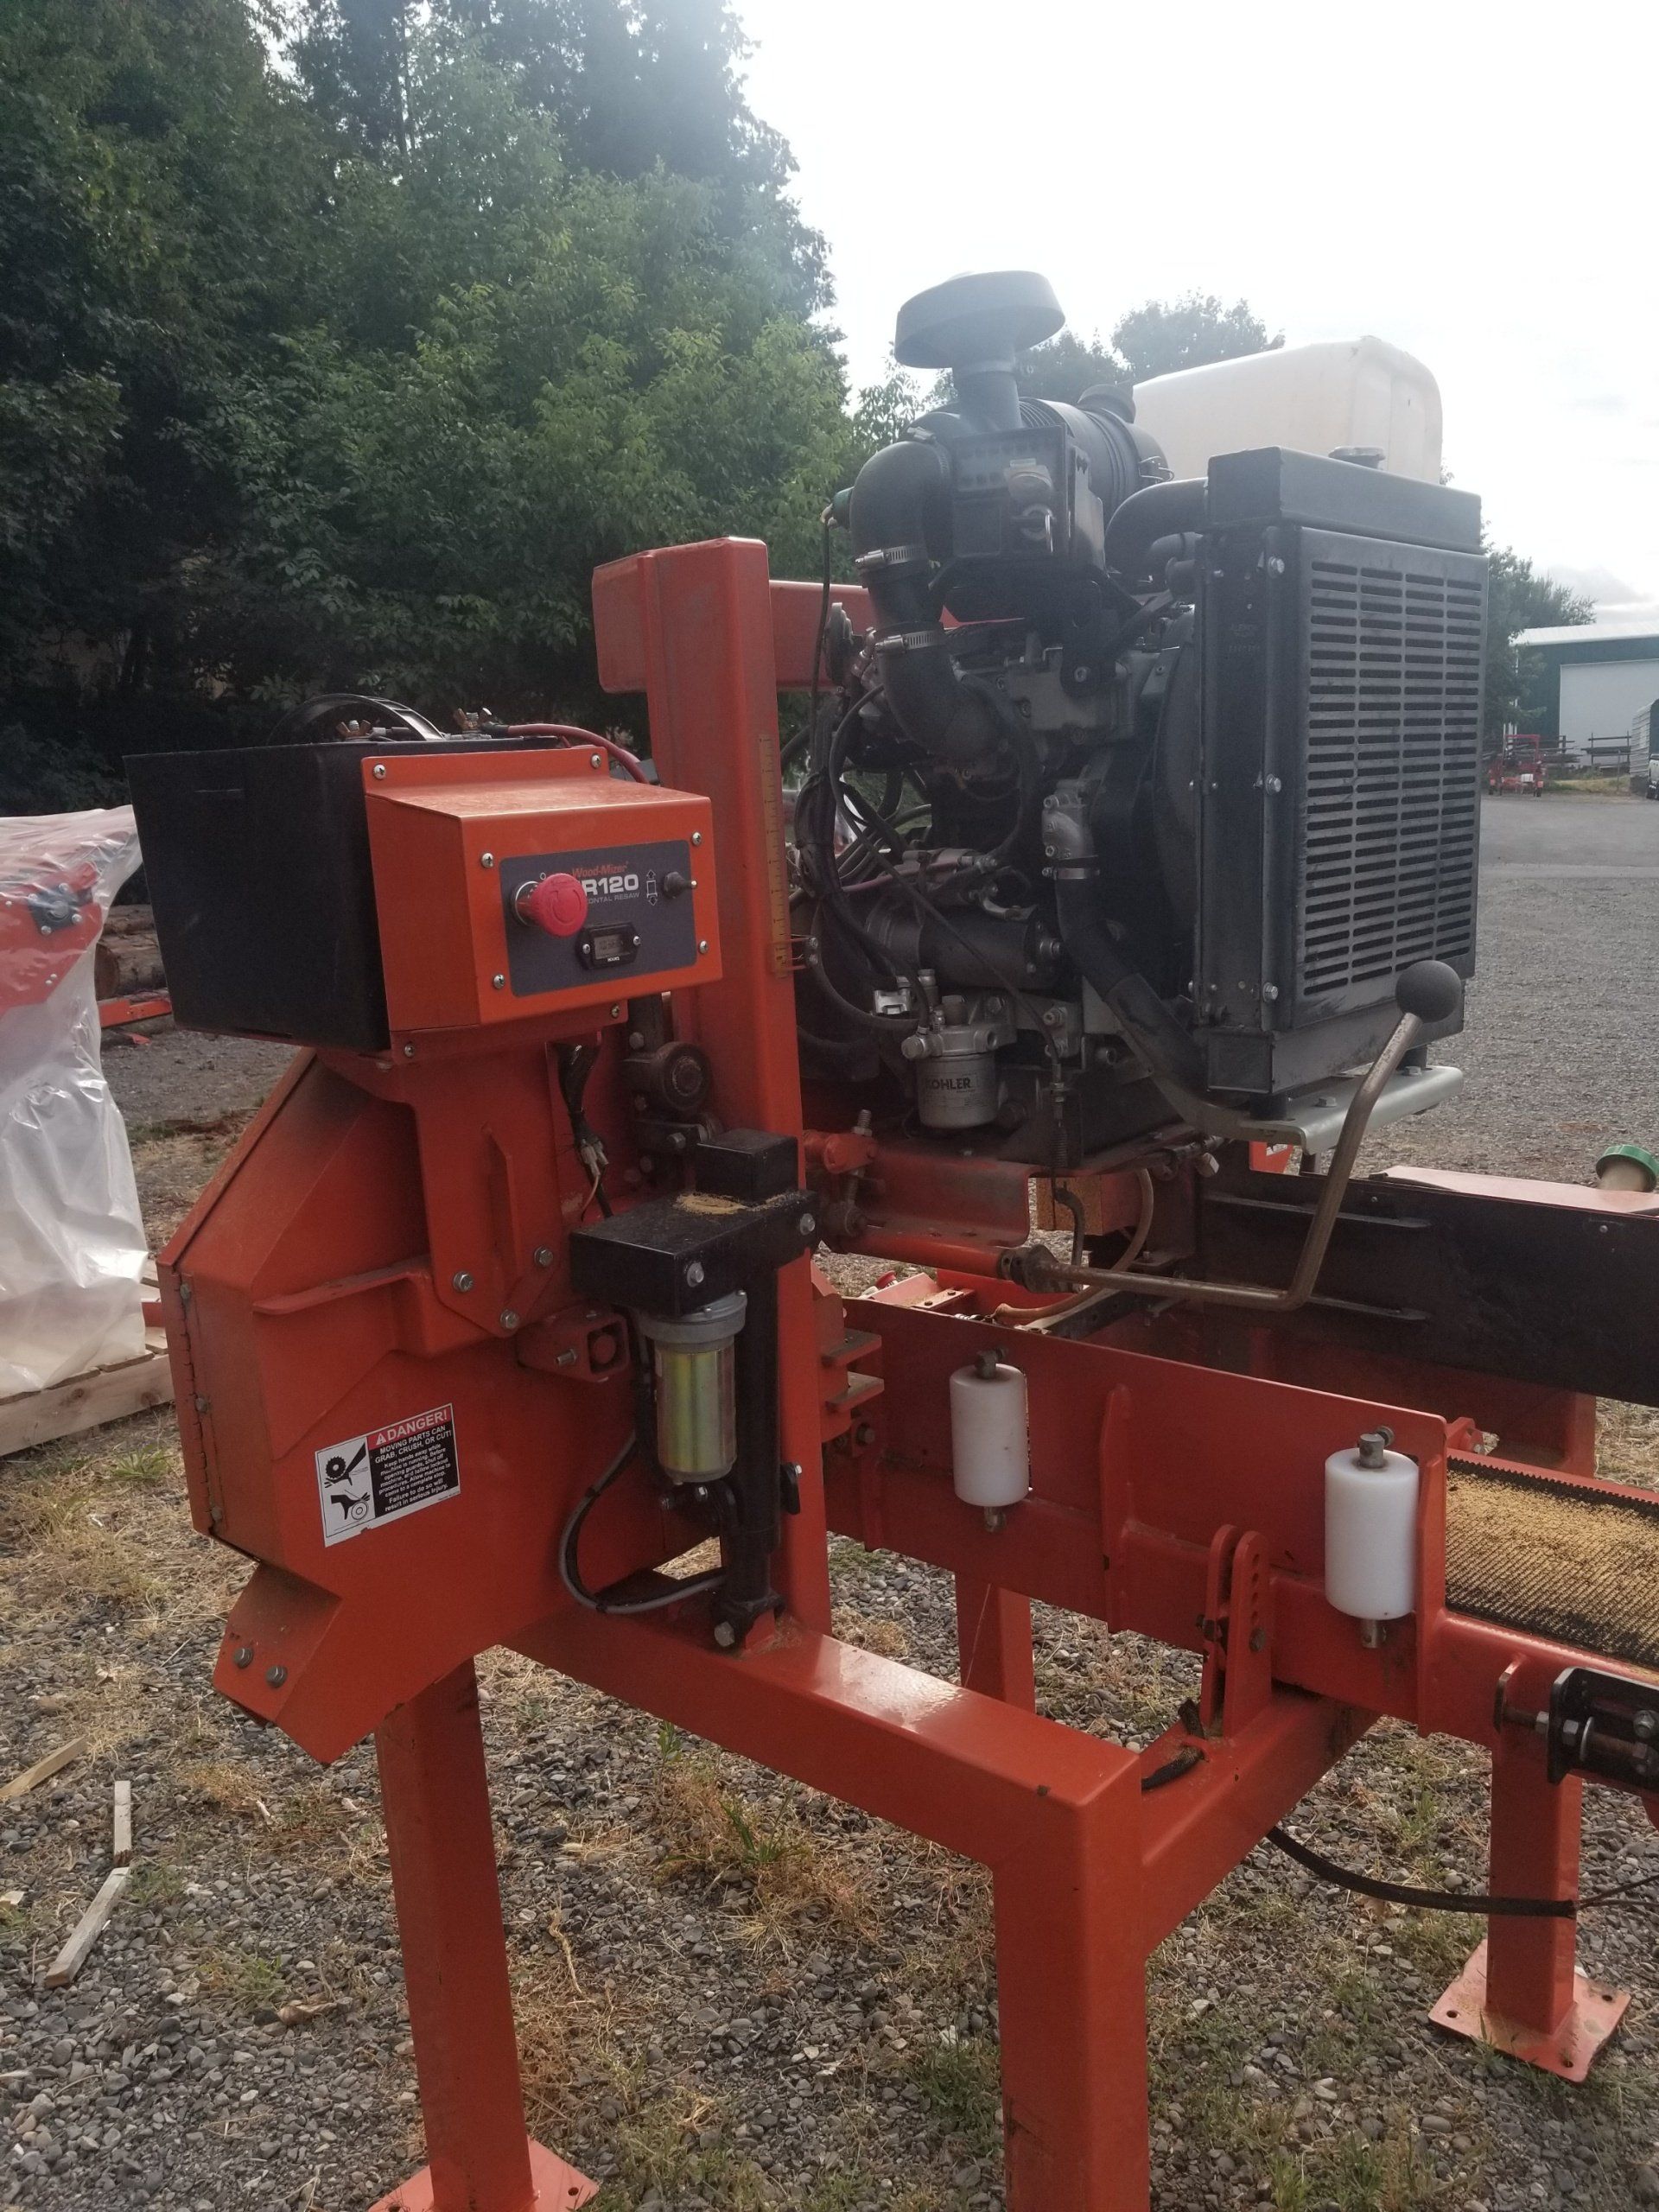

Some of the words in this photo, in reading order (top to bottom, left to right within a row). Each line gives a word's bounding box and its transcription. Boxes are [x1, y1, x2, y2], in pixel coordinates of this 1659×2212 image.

[572, 864, 626, 877] Wood-Mizer
[581, 874, 639, 896] R120
[614, 893, 640, 901] RESAW
[387, 1408, 447, 1441] DANGER!
[375, 1450, 397, 1465] GRAB,
[398, 1440, 423, 1455] CRUSH,
[425, 1436, 435, 1445] OR
[436, 1430, 451, 1440] CUT!
[380, 1439, 407, 1455] MOVING
[409, 1430, 430, 1443] PARTS
[432, 1425, 446, 1434] CAN
[385, 1459, 397, 1469] Keep
[398, 1453, 414, 1463] hands
[415, 1448, 427, 1458] away
[430, 1447, 446, 1457] Before
[385, 1469, 404, 1481] opening
[424, 1465, 444, 1476] machine
[385, 1489, 399, 1497] come
[410, 1475, 433, 1488] complete
[385, 1501, 402, 1511] result
[410, 1490, 430, 1502] serious
[389, 1491, 409, 1503] Failure
